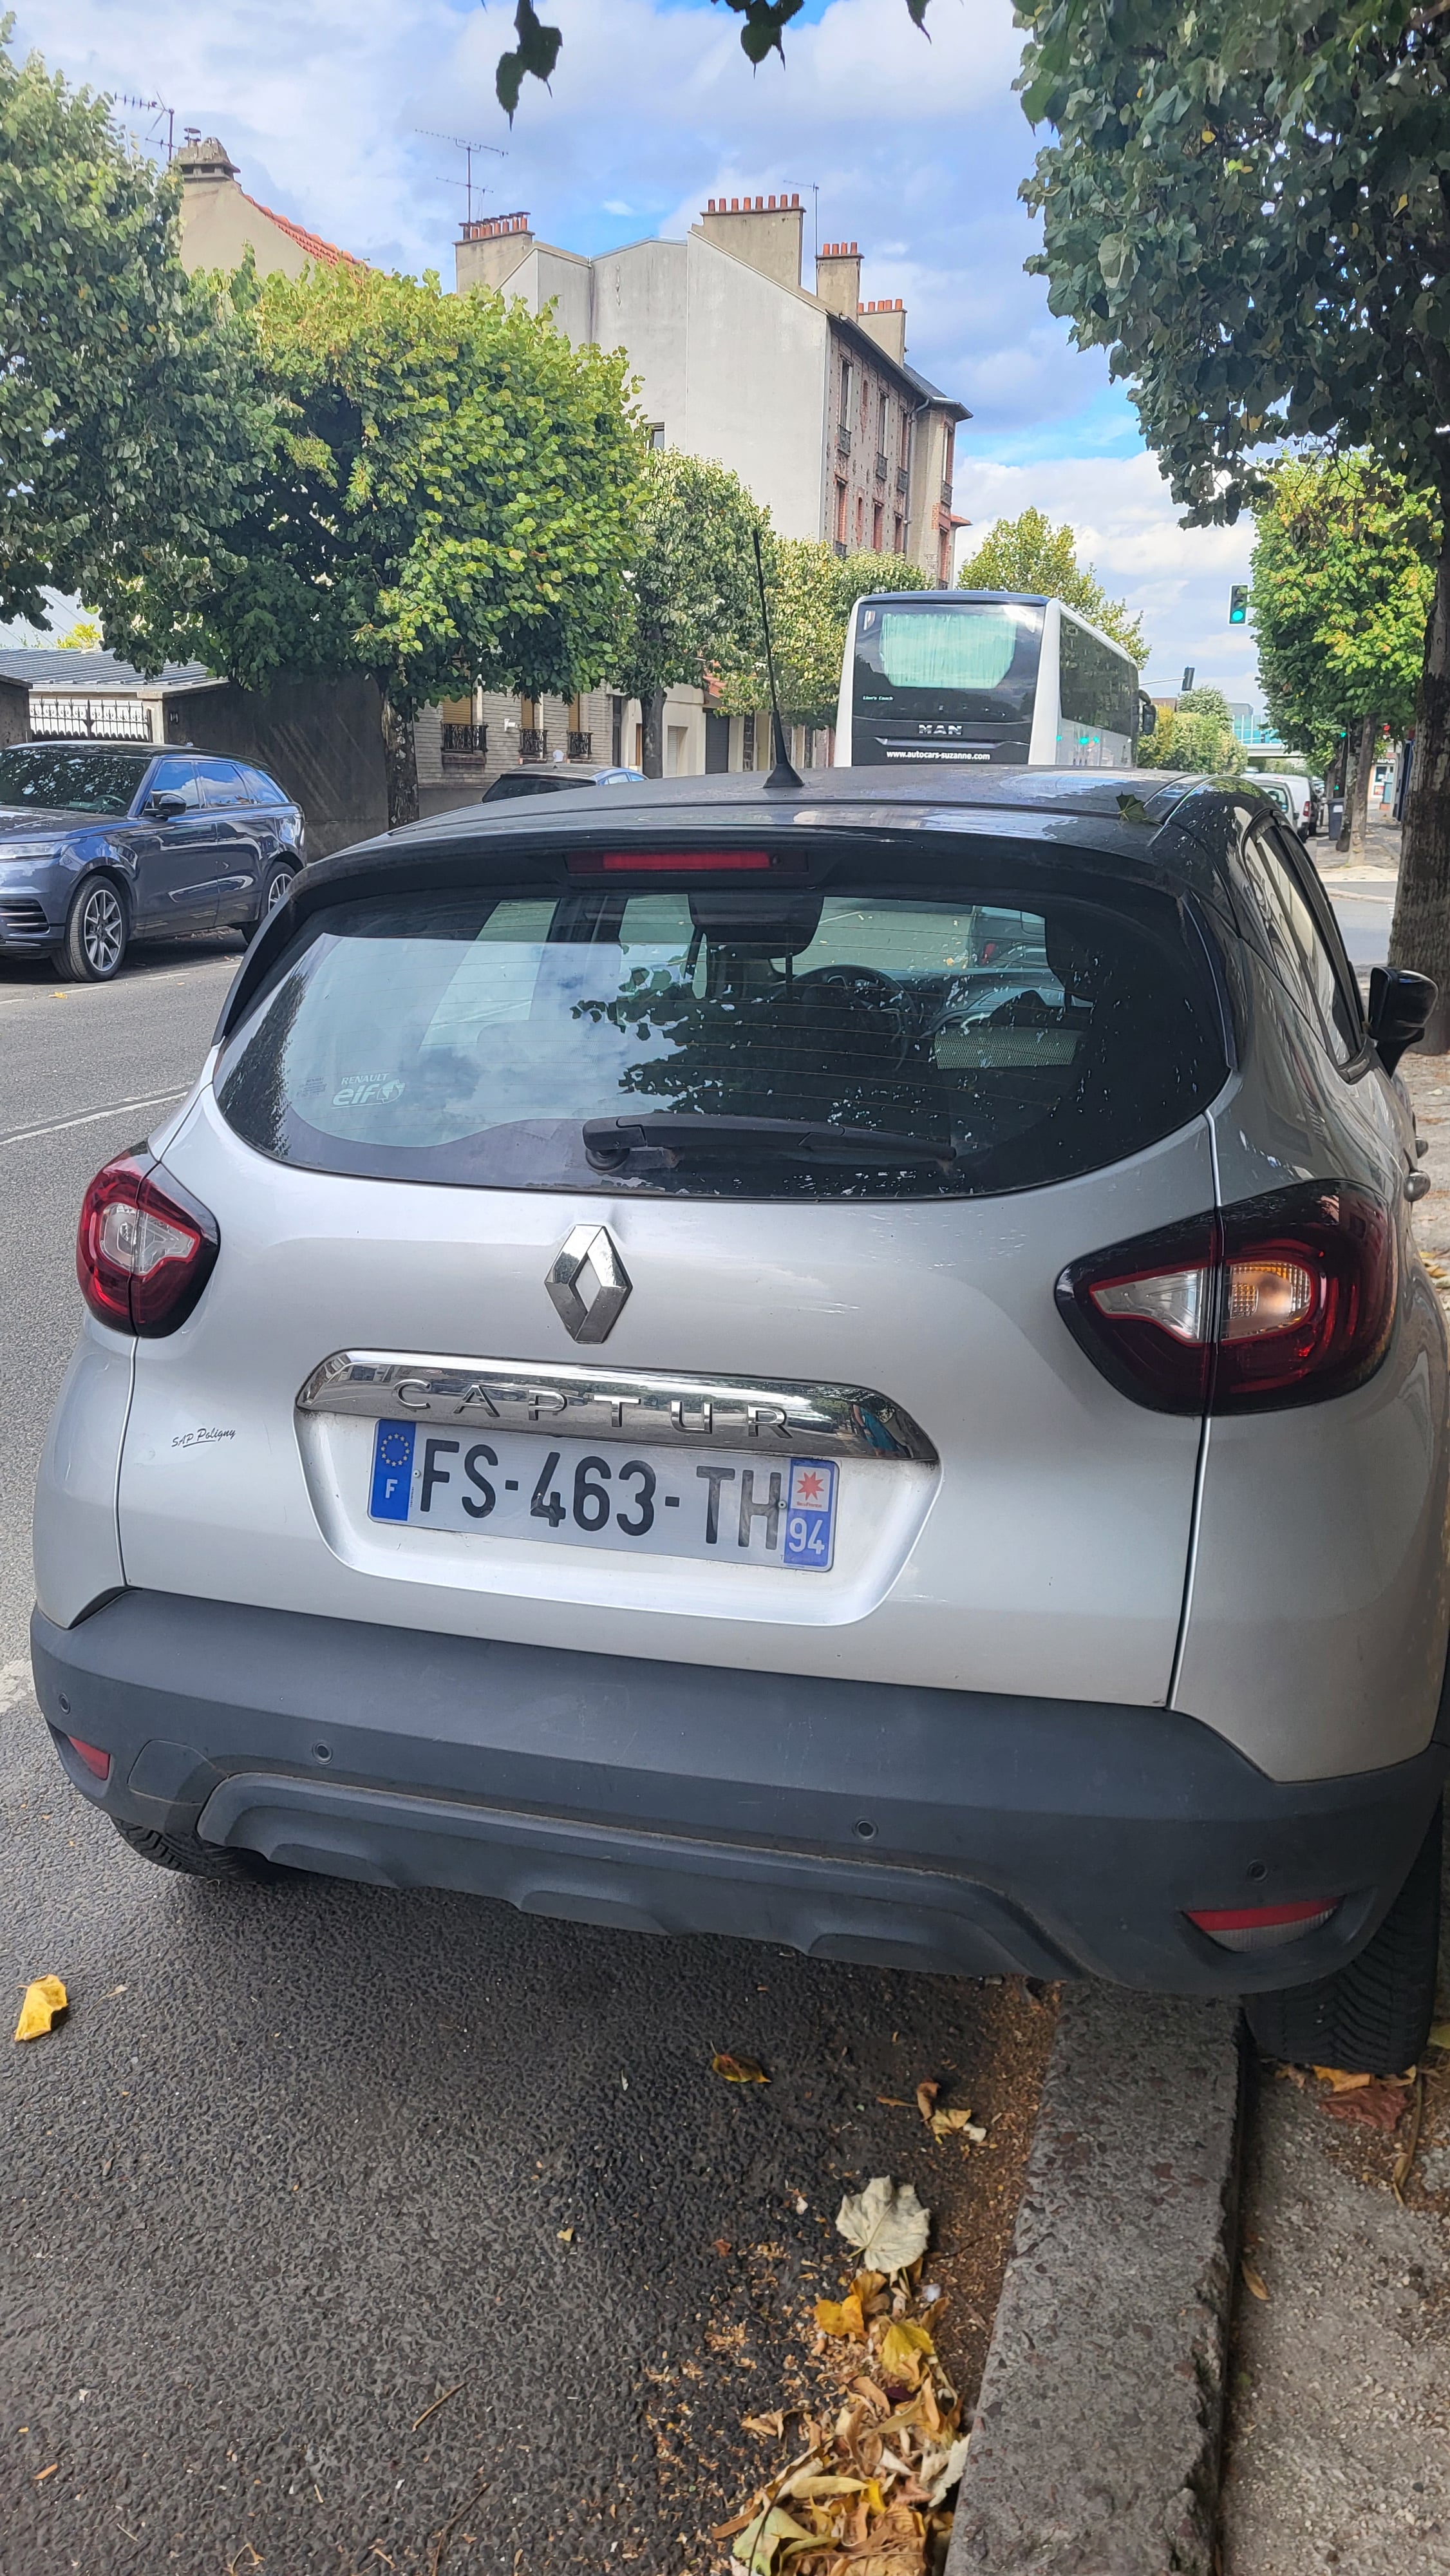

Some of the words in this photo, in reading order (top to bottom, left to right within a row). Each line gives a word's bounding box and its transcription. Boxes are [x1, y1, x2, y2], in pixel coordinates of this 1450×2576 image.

[918, 724, 963, 735] MAN
[886, 750, 990, 761] www.autocars-suzanne.com
[341, 1073, 390, 1085] RENAULT
[332, 1083, 379, 1106] elf
[391, 1379, 793, 1439] CAPTUR
[171, 1433, 194, 1447] SAP
[197, 1427, 236, 1441] Poligny
[385, 1479, 398, 1499] F
[420, 1439, 782, 1550] FS-463-TH
[789, 1517, 825, 1555] 94
